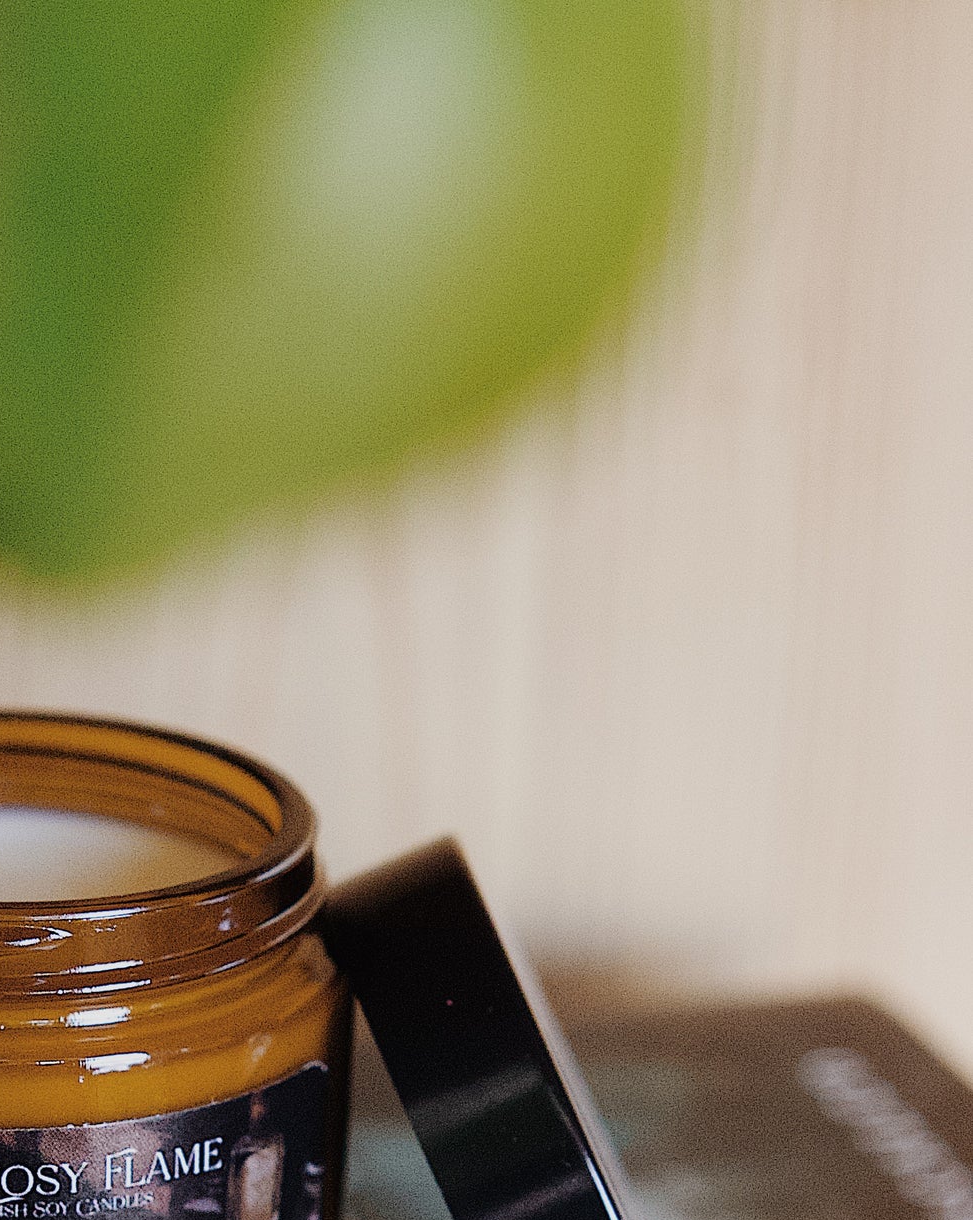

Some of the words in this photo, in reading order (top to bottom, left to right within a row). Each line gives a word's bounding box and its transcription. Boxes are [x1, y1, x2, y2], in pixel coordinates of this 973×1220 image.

[104, 1137, 223, 1190] FLAME
[33, 1200, 68, 1218] SOY
[77, 1191, 155, 1217] CANDLES
